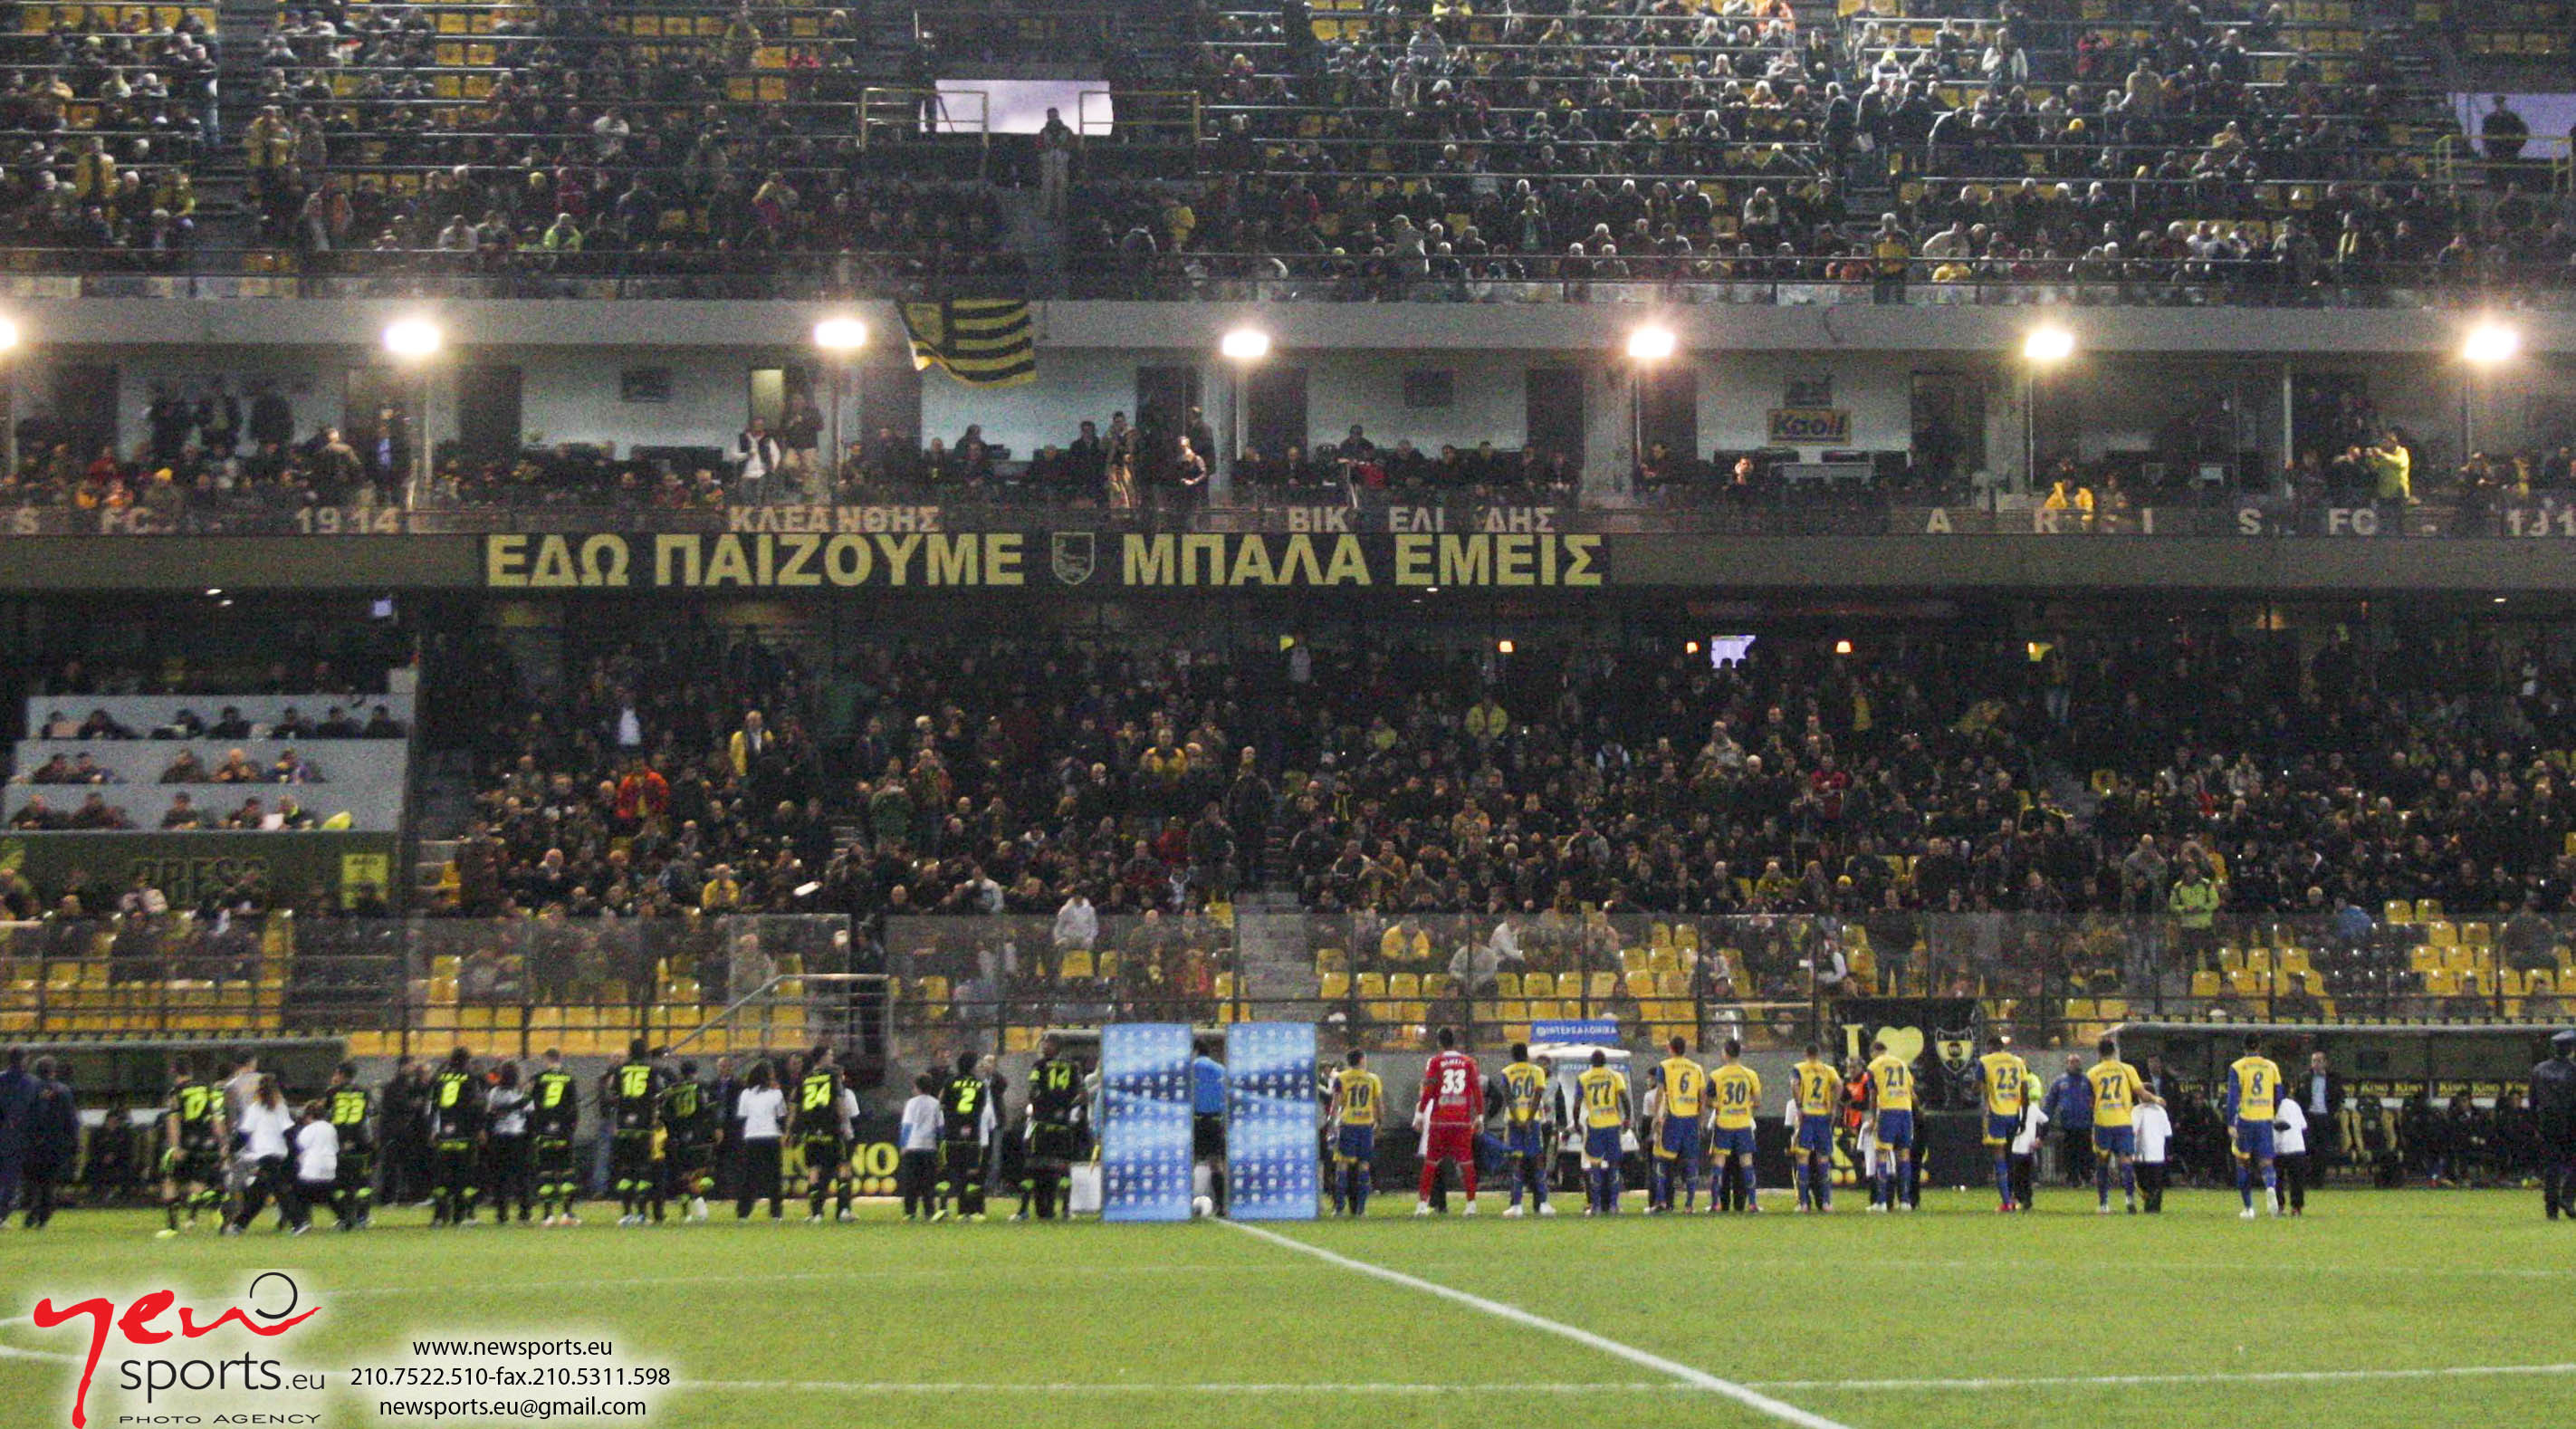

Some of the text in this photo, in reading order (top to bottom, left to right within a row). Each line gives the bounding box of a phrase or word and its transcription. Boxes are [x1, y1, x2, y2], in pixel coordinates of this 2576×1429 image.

[101, 507, 152, 534] FC
[487, 533, 1025, 587] ΕΔΩ ΠΑΙΖΟΥΜΕ
[1122, 533, 1603, 587] ΜΠΑΛΑ ΕΜΕΙΣ
[621, 1071, 649, 1098] 16
[1049, 1068, 1070, 1090] 14
[1441, 1069, 1466, 1095] 33
[1680, 1072, 1691, 1095] 6
[1811, 1075, 1824, 1099] 2
[1995, 1067, 2019, 1090] 23
[2099, 1074, 2123, 1100] 27
[803, 1081, 830, 1111] 24
[956, 1088, 977, 1115] 2
[1586, 1079, 1613, 1106] 77
[1722, 1080, 1747, 1106] 30
